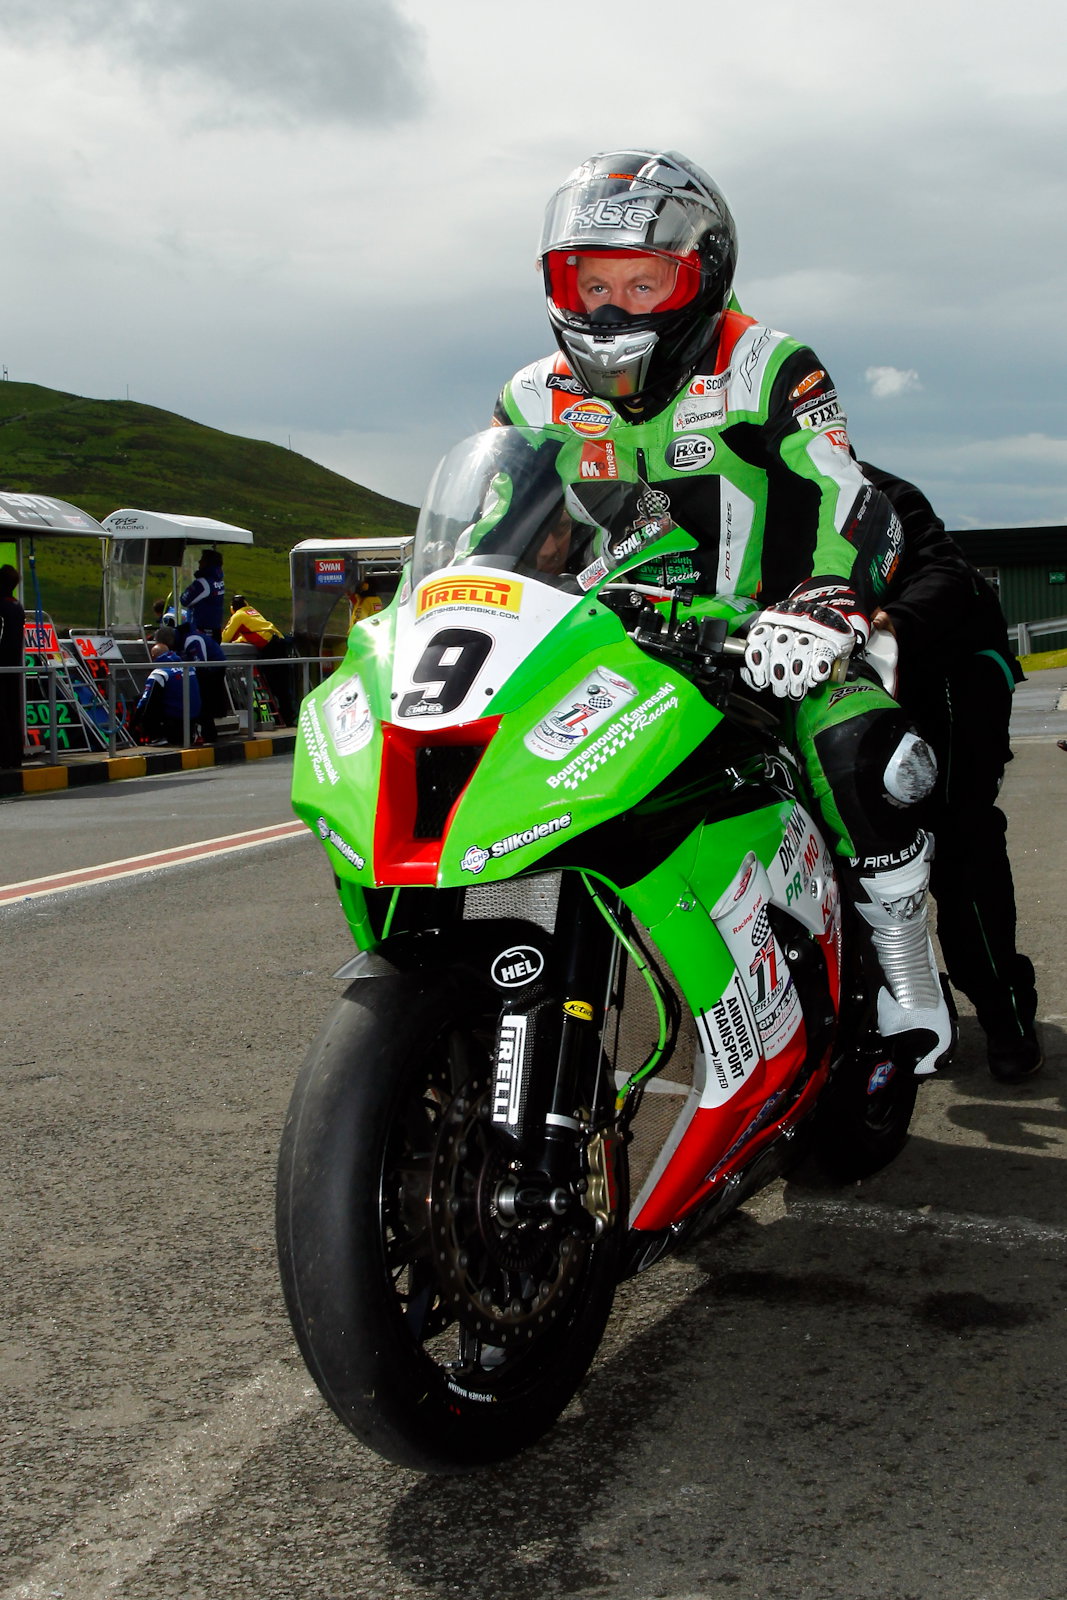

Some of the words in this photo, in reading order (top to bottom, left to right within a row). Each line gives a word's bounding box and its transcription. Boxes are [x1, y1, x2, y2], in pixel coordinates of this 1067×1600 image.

[676, 441, 706, 458] R&G
[613, 521, 662, 560] STALKER
[420, 579, 512, 612] PIRELLI
[397, 628, 493, 718] 9
[635, 695, 679, 732] Racing
[545, 722, 624, 790] Bournemouth
[619, 682, 676, 727] Kawasaki
[461, 849, 490, 870] FUCHS
[500, 959, 537, 982] HEL
[711, 997, 745, 1080] TRANSPORT
[726, 996, 754, 1062] ANDOVER
[492, 1015, 528, 1125] PIRELLI
[712, 1058, 729, 1090] LIMITED
